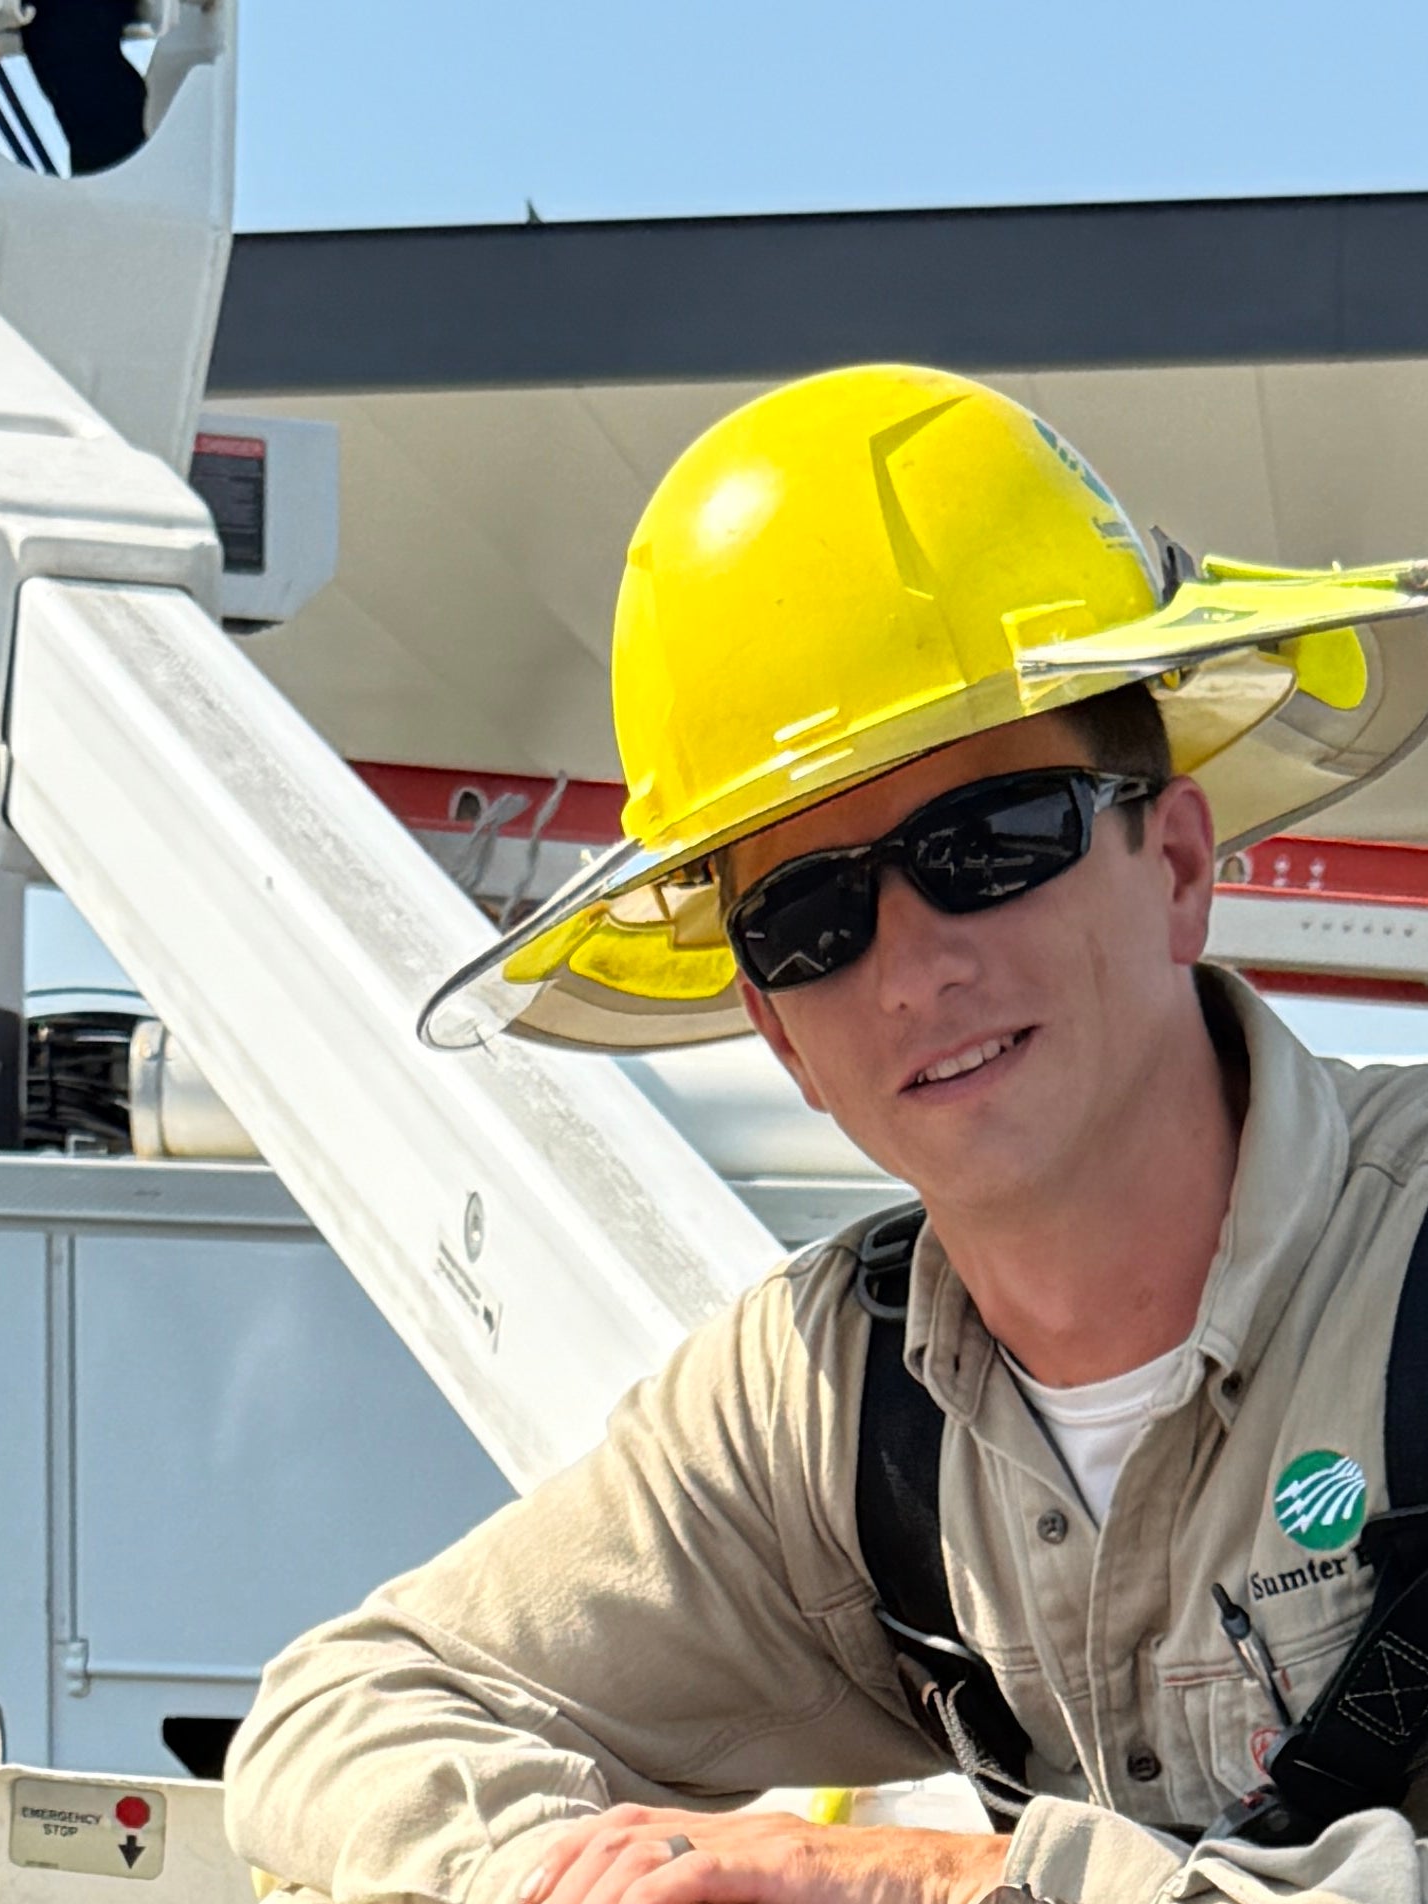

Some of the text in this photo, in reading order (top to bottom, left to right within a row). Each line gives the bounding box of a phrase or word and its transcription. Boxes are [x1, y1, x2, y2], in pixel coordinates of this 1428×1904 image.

[1249, 1556, 1348, 1601] Sumter
[21, 1806, 104, 1826] EMERGENCY
[42, 1823, 79, 1838] STOP
